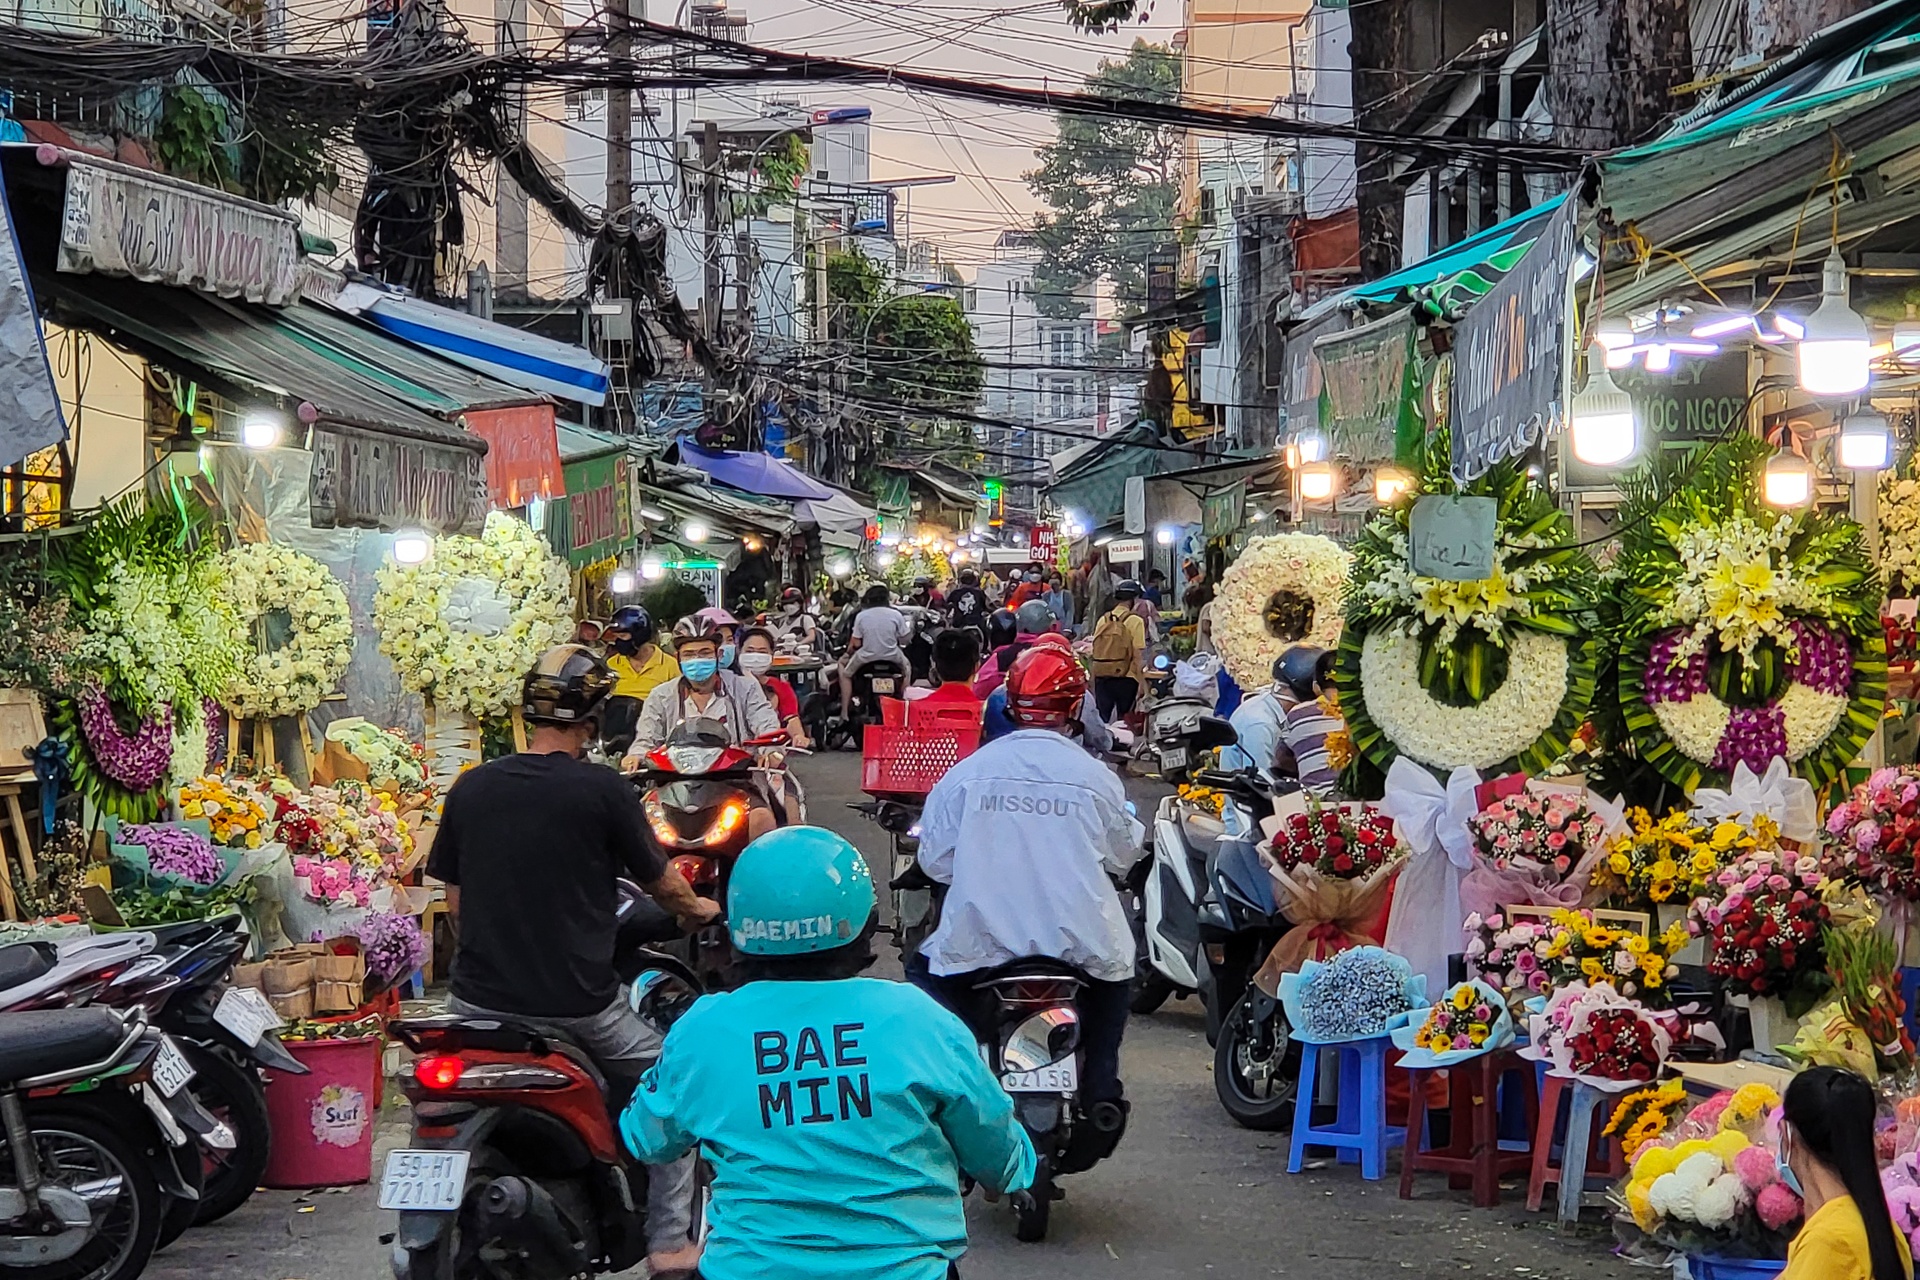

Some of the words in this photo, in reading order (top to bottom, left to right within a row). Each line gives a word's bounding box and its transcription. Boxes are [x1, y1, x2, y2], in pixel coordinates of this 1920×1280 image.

[1030, 544, 1049, 560] GÓI
[741, 914, 832, 941] BAEMIN
[754, 1022, 867, 1075] BAE
[156, 1057, 191, 1094] 15210
[758, 1073, 872, 1129] MIN
